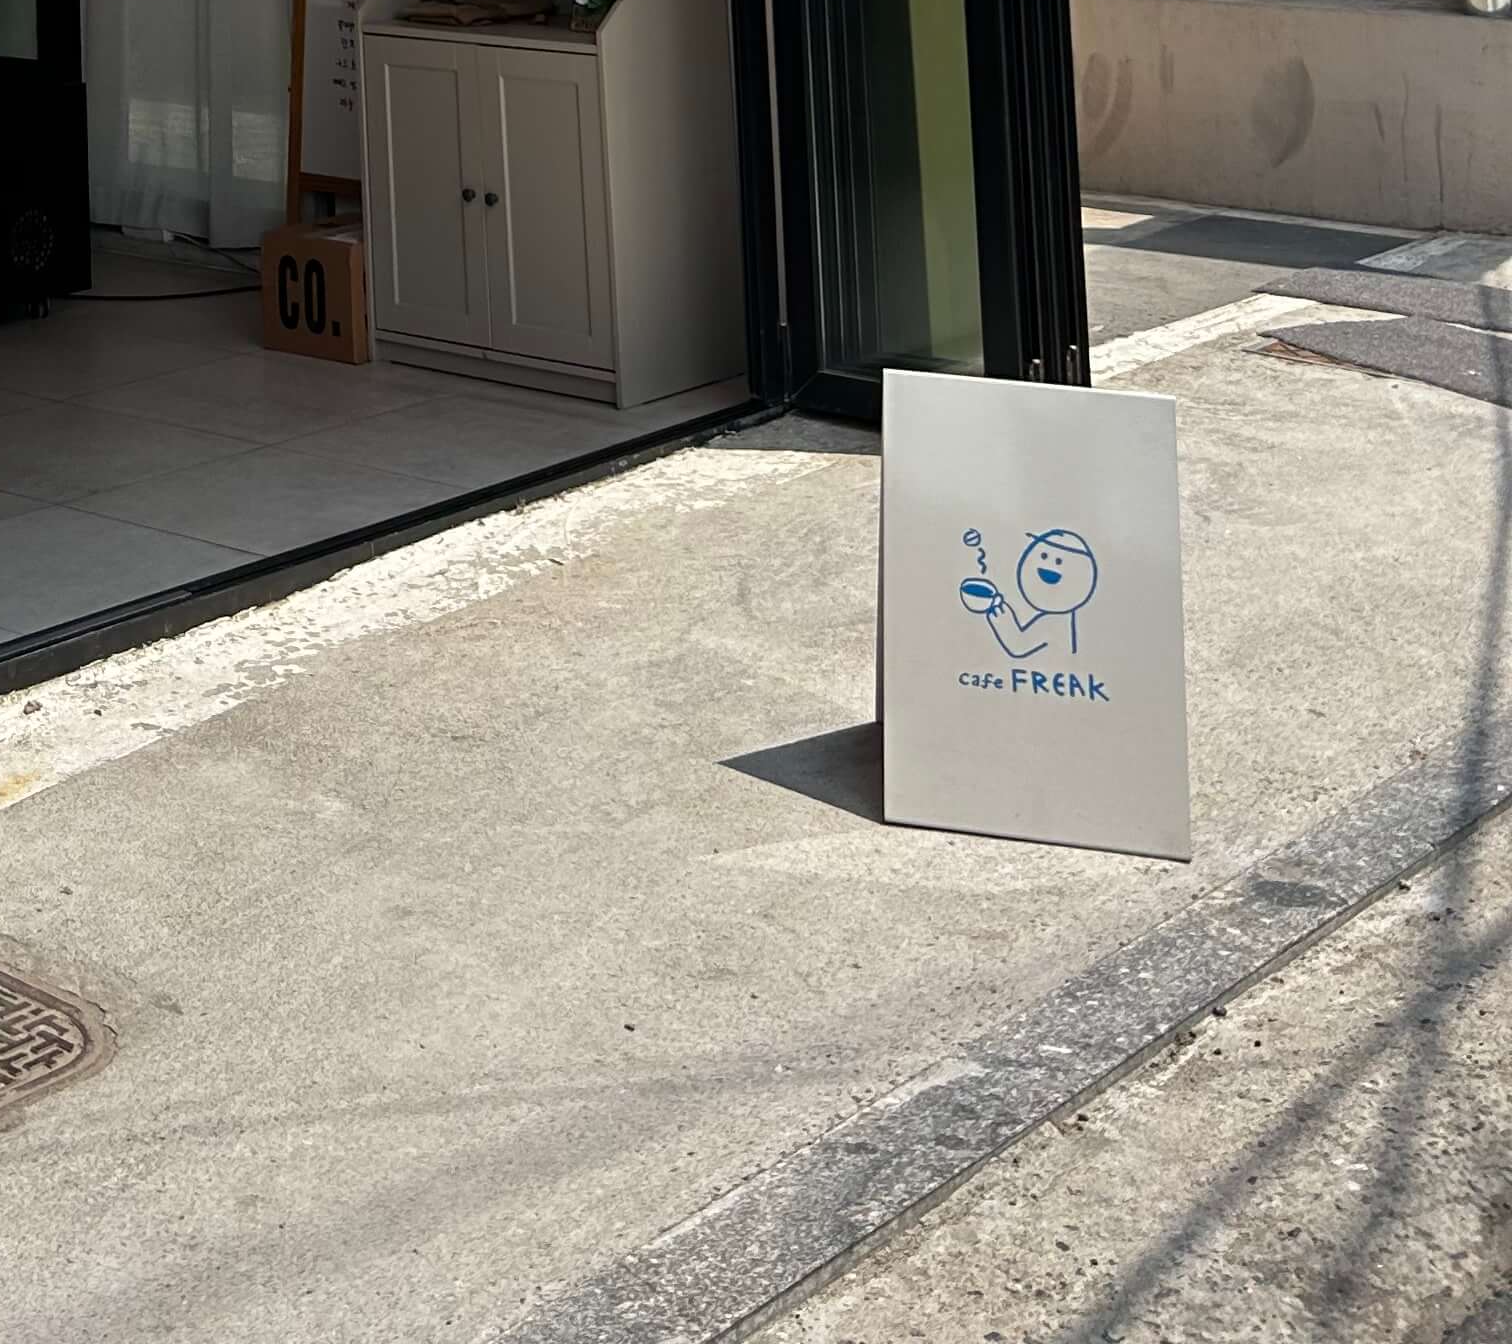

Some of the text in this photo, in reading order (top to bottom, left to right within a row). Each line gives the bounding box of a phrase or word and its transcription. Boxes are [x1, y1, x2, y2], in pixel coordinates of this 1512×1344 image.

[278, 255, 341, 337] CO.
[959, 668, 1109, 702] cafe FREAK
